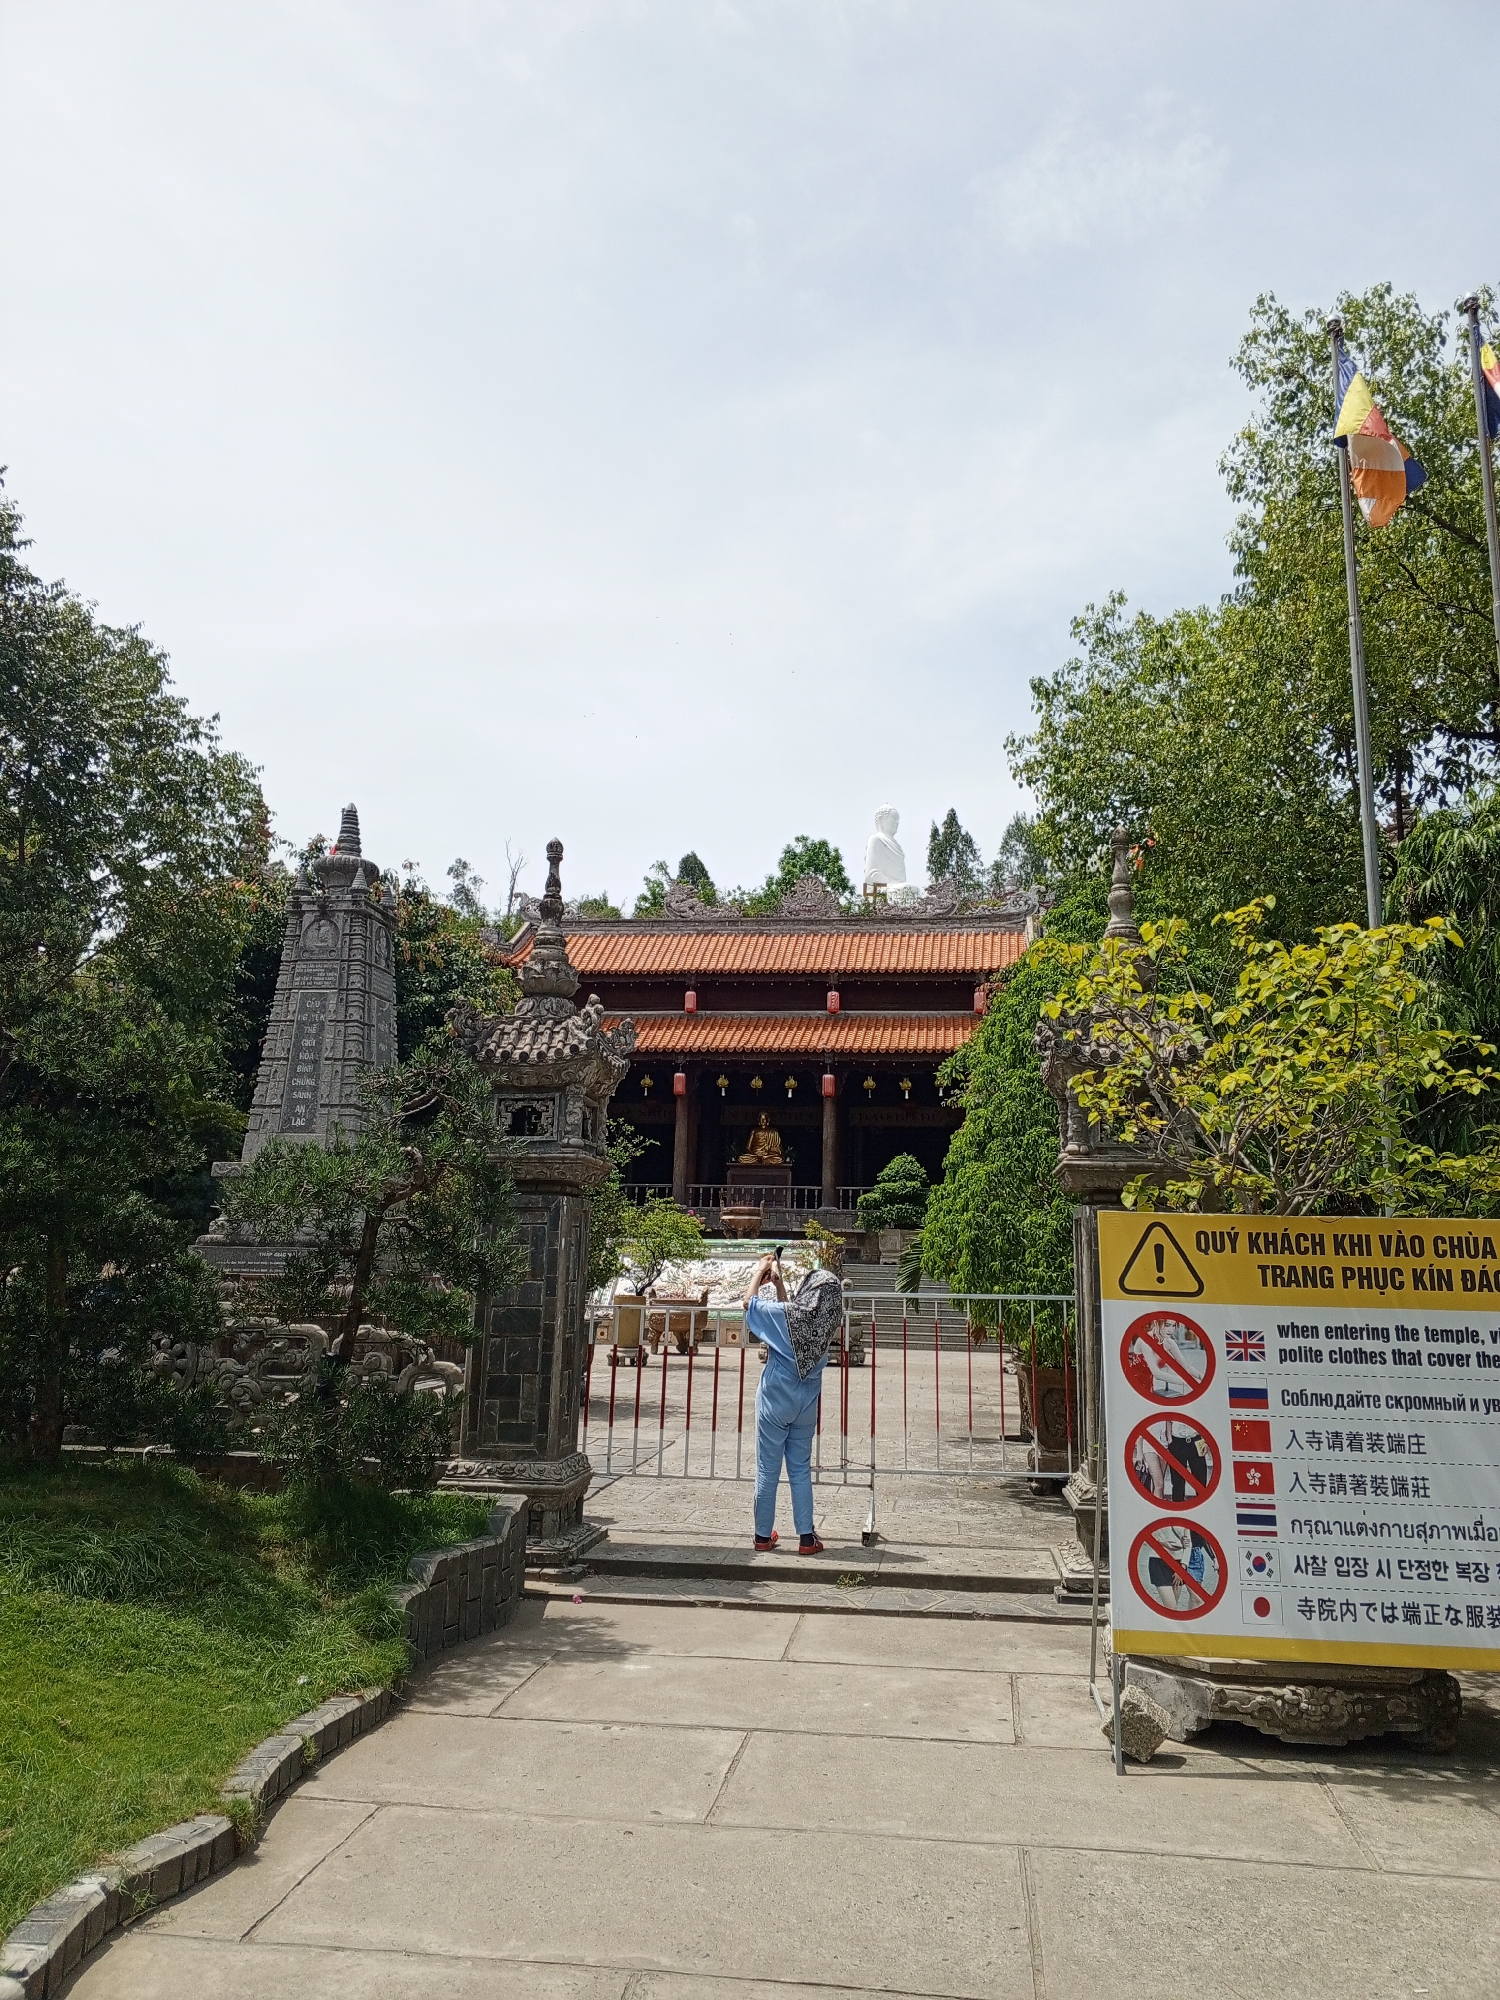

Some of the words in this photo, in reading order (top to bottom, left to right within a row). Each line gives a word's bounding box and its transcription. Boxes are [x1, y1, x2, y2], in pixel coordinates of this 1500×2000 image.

[1195, 1226, 1240, 1256] QUÝ
[1247, 1227, 1326, 1256] KHÁCH
[1332, 1233, 1373, 1257] KHI
[1378, 1229, 1425, 1258] VÀO
[1433, 1230, 1498, 1260] CHÙA
[1257, 1264, 1335, 1289] TRANG
[1341, 1266, 1405, 1296] PHỤC
[1411, 1263, 1454, 1291] KÍN
[1276, 1321, 1320, 1340] when
[1324, 1323, 1390, 1343] entering
[1394, 1324, 1420, 1342] the
[1424, 1325, 1485, 1346] temple,
[1278, 1345, 1324, 1364] polite
[1328, 1346, 1387, 1365] clothes
[1391, 1348, 1423, 1366] that
[1427, 1352, 1471, 1368] cover
[1281, 1388, 1381, 1410] Соблюдайте
[1385, 1393, 1466, 1412] скромный
[1469, 1397, 1480, 1412] и
[1285, 1429, 1427, 1455] 入寺请着装端庄
[1289, 1471, 1431, 1498] 入寺請著裝端莊
[1290, 1510, 1500, 1544] กรุณาแต่งกายสุภาพเมื่อ
[1293, 1554, 1327, 1577] 사찰
[1333, 1555, 1370, 1578] 입장
[1375, 1558, 1391, 1579] 시
[1397, 1559, 1449, 1581] 단정한
[1455, 1560, 1490, 1583] 복장
